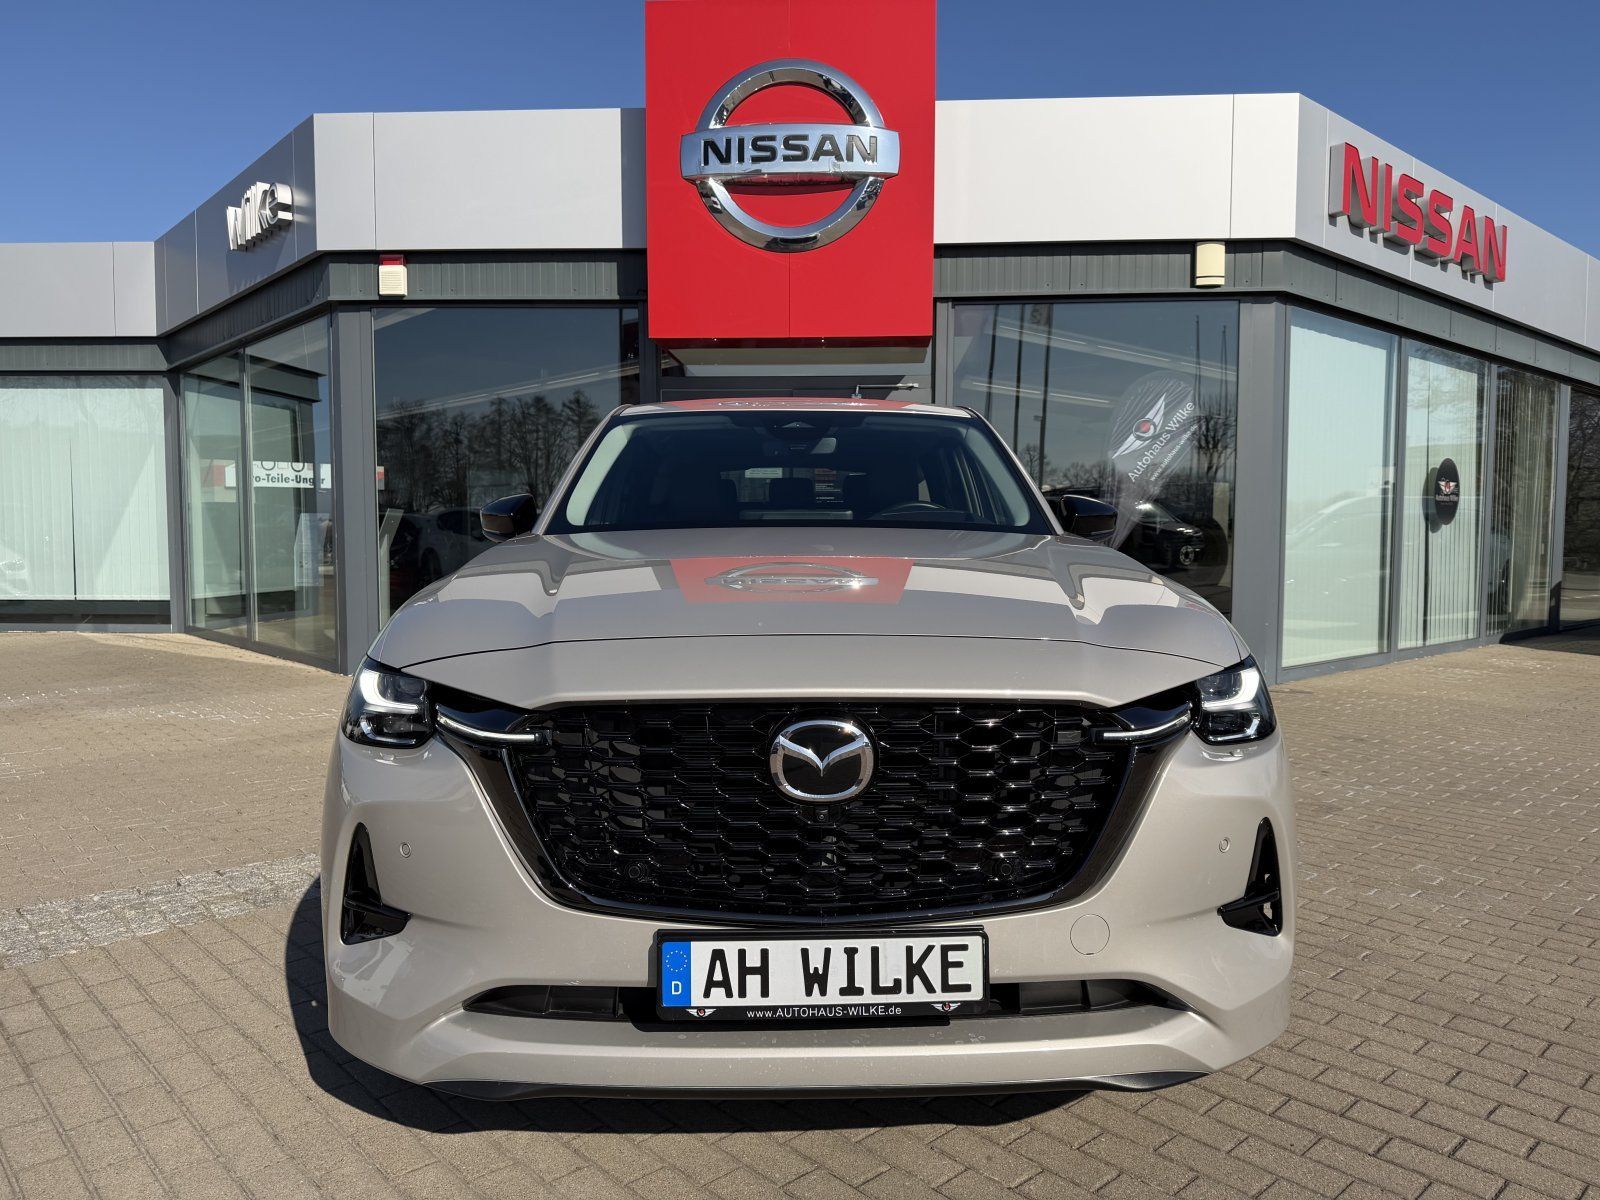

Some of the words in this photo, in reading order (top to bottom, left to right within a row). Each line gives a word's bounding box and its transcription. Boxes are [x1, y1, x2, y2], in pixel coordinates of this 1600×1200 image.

[702, 133, 878, 166] NISSAN
[1341, 142, 1508, 283] NISSAN
[1128, 432, 1171, 482] Autohaus
[1165, 402, 1195, 432] Wilke
[671, 980, 682, 995] D
[702, 948, 770, 999] AH
[800, 943, 972, 998] WILKE
[746, 1004, 902, 1018] www.AUTOHAUS-WILKE.de
